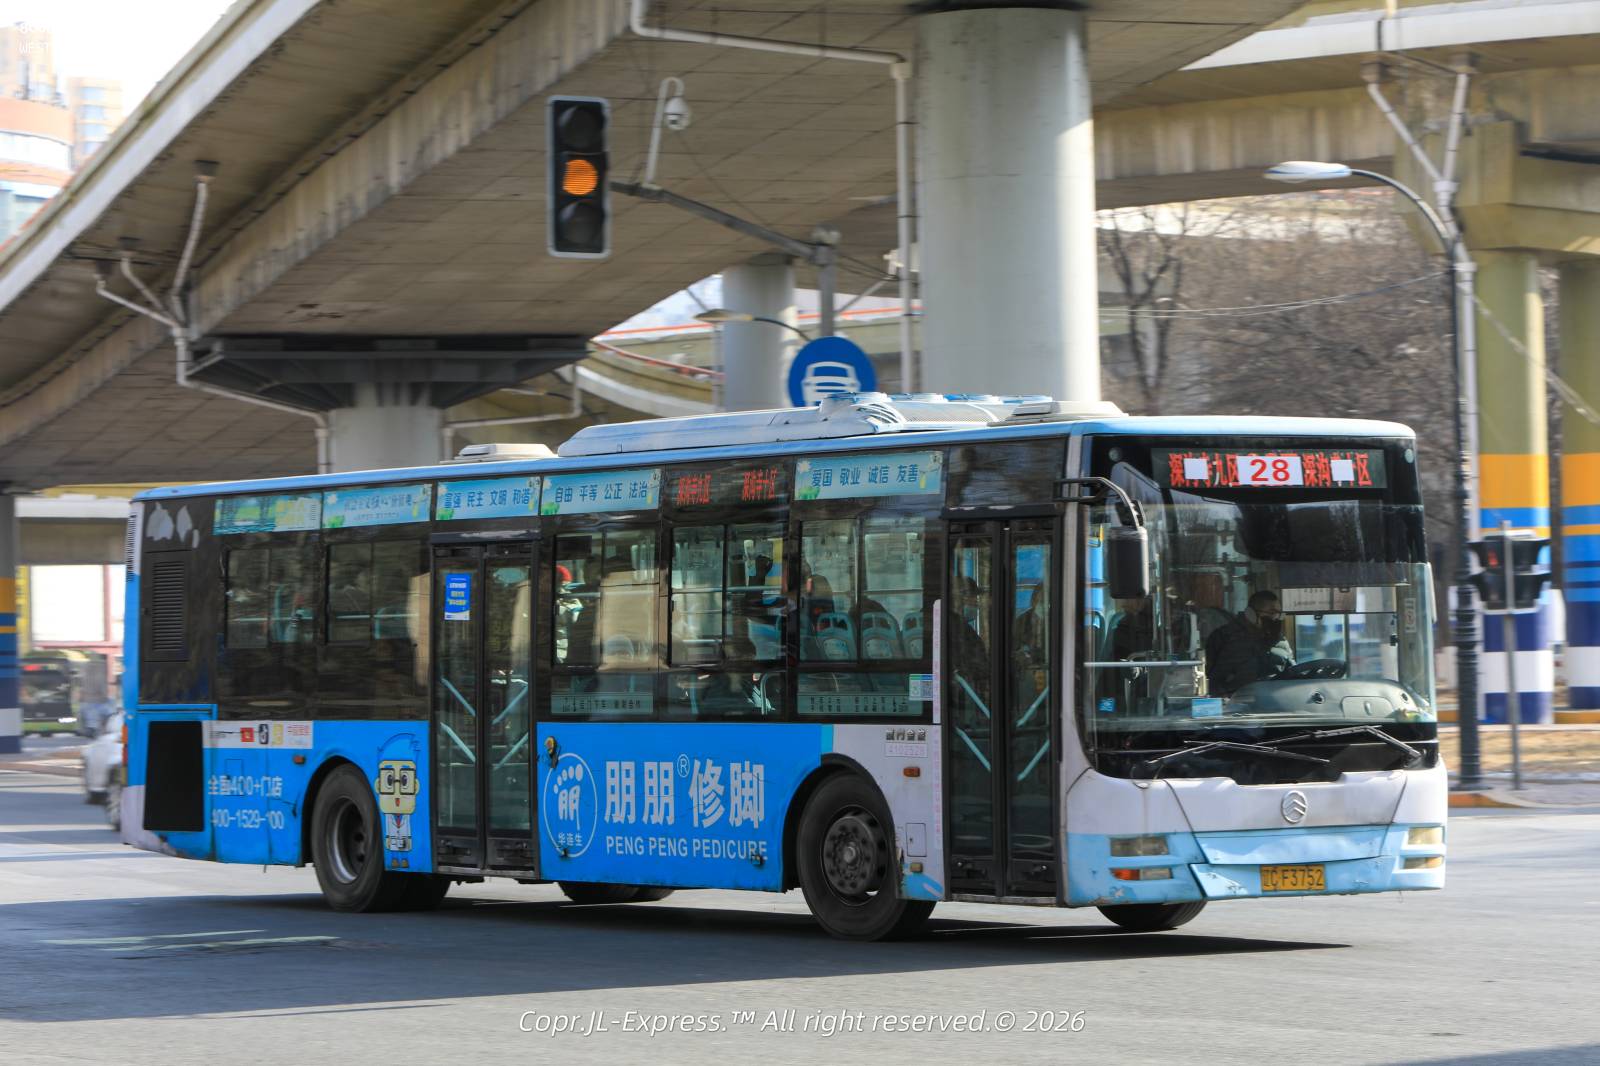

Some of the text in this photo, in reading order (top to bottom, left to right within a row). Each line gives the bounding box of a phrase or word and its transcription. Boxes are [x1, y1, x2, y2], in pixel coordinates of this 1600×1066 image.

[811, 463, 919, 488] 爱国 敬业 诚信 友善
[1250, 459, 1290, 482] 28
[445, 488, 530, 509] 富强 民主 文明 和谐
[555, 480, 647, 503] 自由 平等 公正 法治
[606, 836, 768, 861] PENG PENG PEDICURE
